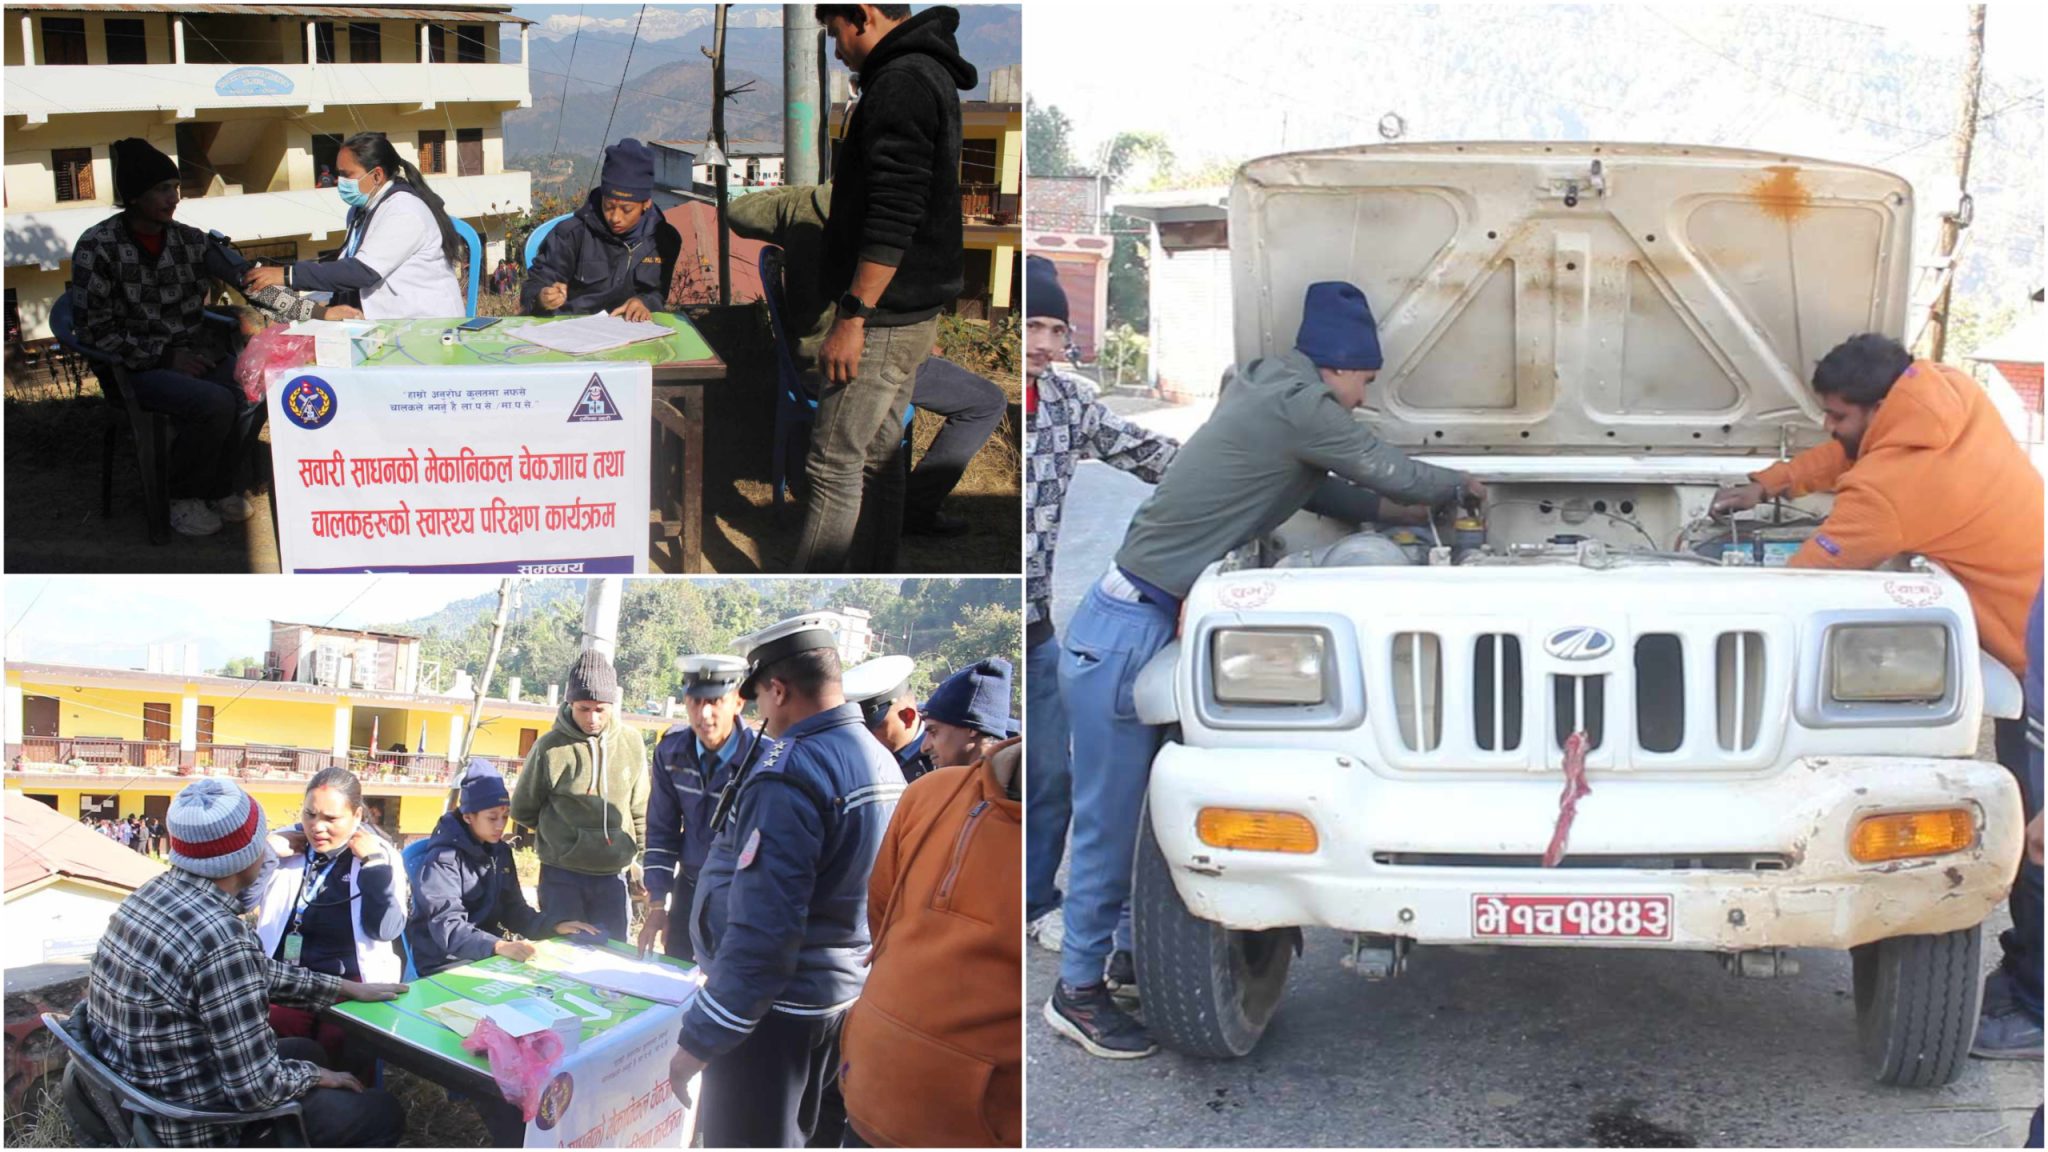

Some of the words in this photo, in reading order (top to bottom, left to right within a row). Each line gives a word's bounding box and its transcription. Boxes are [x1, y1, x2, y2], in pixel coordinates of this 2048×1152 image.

[298, 449, 345, 488] सवारी
[350, 447, 419, 488] साधनको
[424, 446, 513, 484] मेकानिकल
[593, 450, 626, 480] तथा
[415, 508, 475, 538] स्वास्थ्य
[480, 496, 540, 536] परिक्षण
[545, 496, 616, 532] कार्यक्रम
[517, 562, 584, 574] समन्वय
